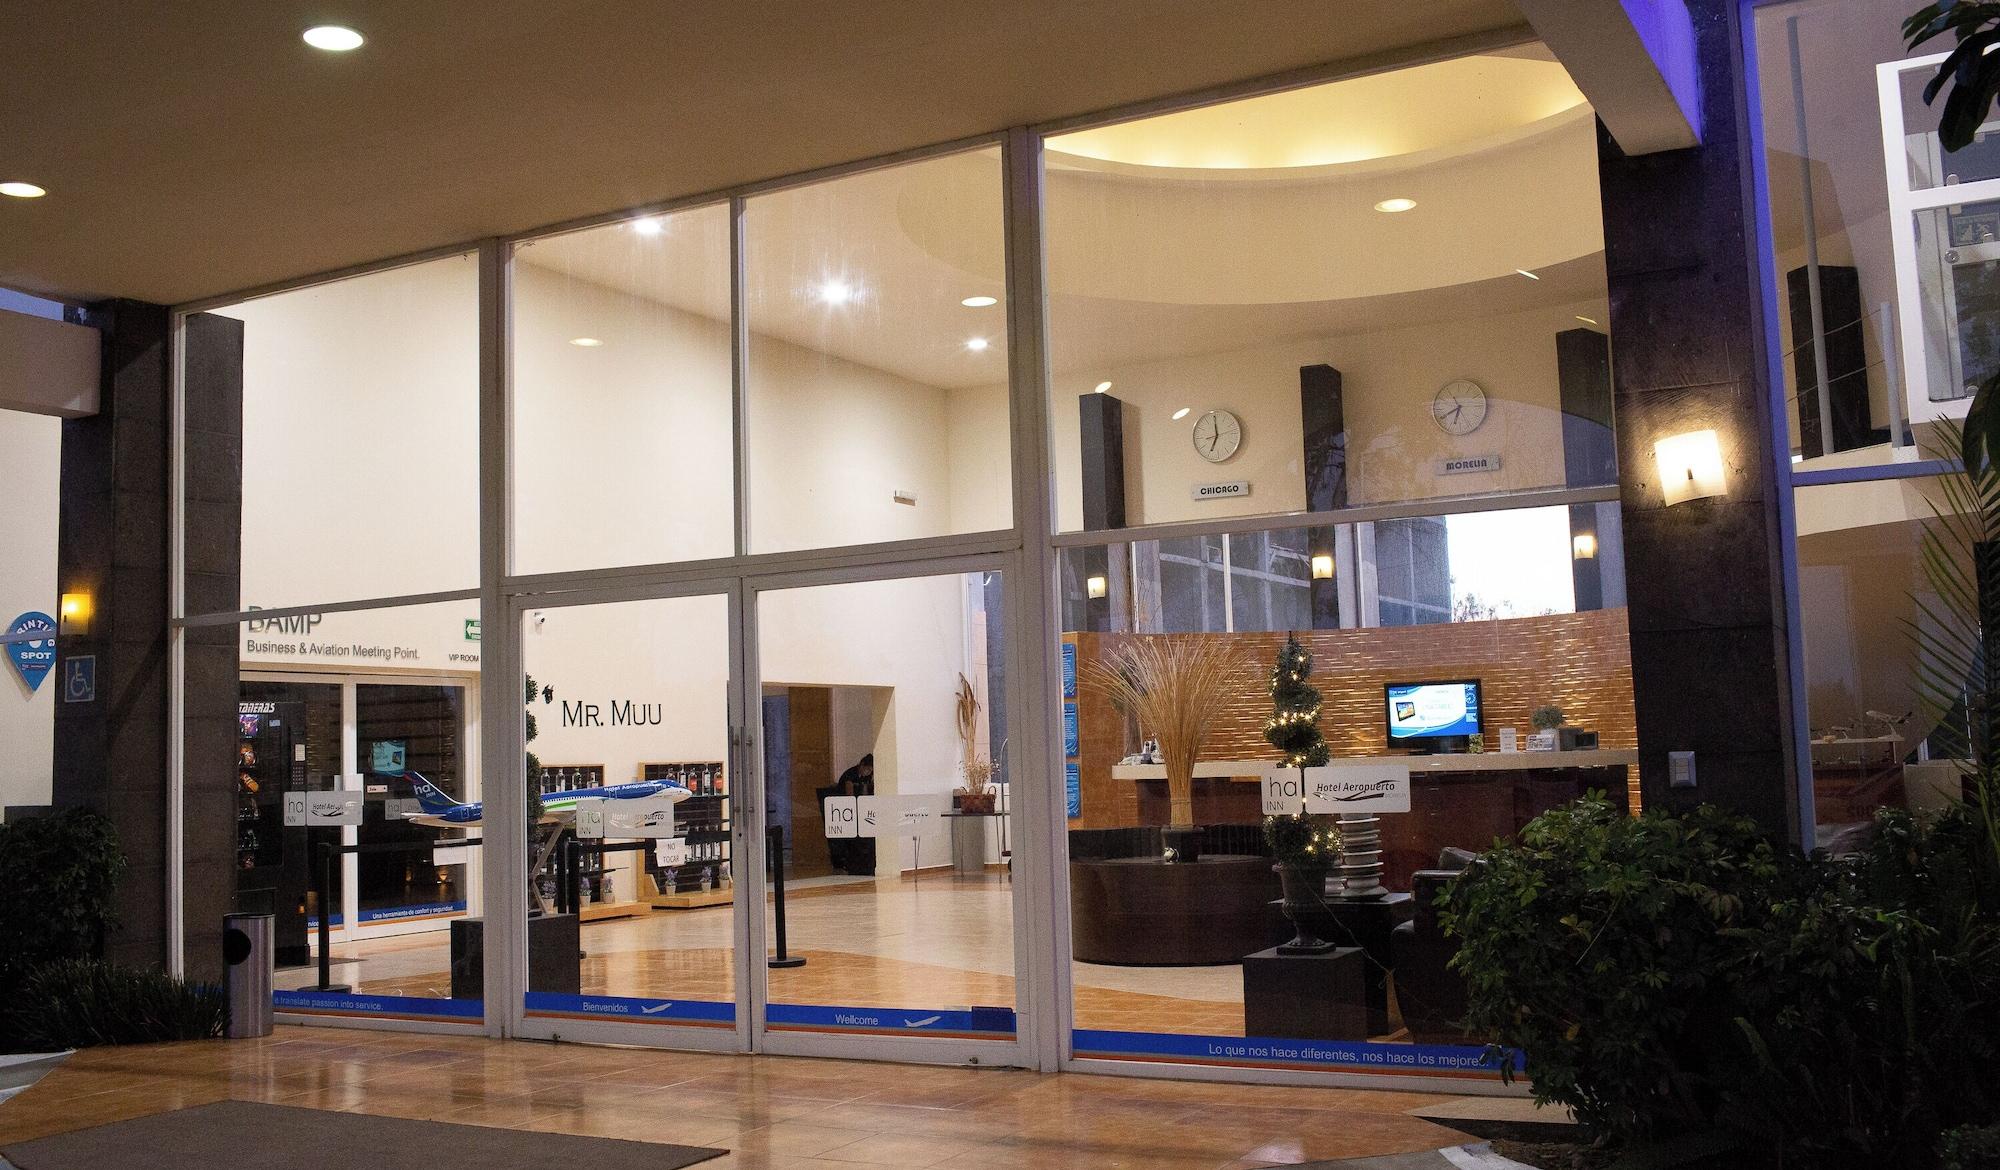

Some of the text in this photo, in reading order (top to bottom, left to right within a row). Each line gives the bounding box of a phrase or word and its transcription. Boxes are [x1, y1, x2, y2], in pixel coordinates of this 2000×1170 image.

[1446, 459, 1488, 470] MORELIA
[1200, 485, 1239, 495] CHICAGO
[20, 651, 52, 660] SPOT
[247, 640, 421, 661] Business & Aviation Meeting Point.
[449, 653, 479, 662] VIP ROOM
[239, 702, 275, 713] TANERAS
[562, 700, 662, 727] MR. MUU
[413, 784, 431, 795] ha
[1269, 776, 1297, 797] ha
[1316, 782, 1395, 795] Hotel Aeropuerto
[288, 798, 304, 813] ha
[1266, 801, 1284, 811] INN
[831, 804, 853, 822] ha
[828, 825, 843, 835] INN
[667, 843, 676, 851] NO
[311, 999, 340, 1008] passion
[341, 1000, 354, 1009] into
[583, 1002, 628, 1013] Bienvenidos
[835, 1013, 879, 1026] Wellcome
[1208, 1043, 1223, 1055] Lo
[1225, 1046, 1246, 1057] que
[1248, 1048, 1268, 1057] nos
[1271, 1046, 1298, 1058] hace
[1301, 1047, 1360, 1063] diferentes,
[1362, 1052, 1384, 1063] nos
[1386, 1051, 1415, 1064] hace
[1418, 1053, 1435, 1065] los
